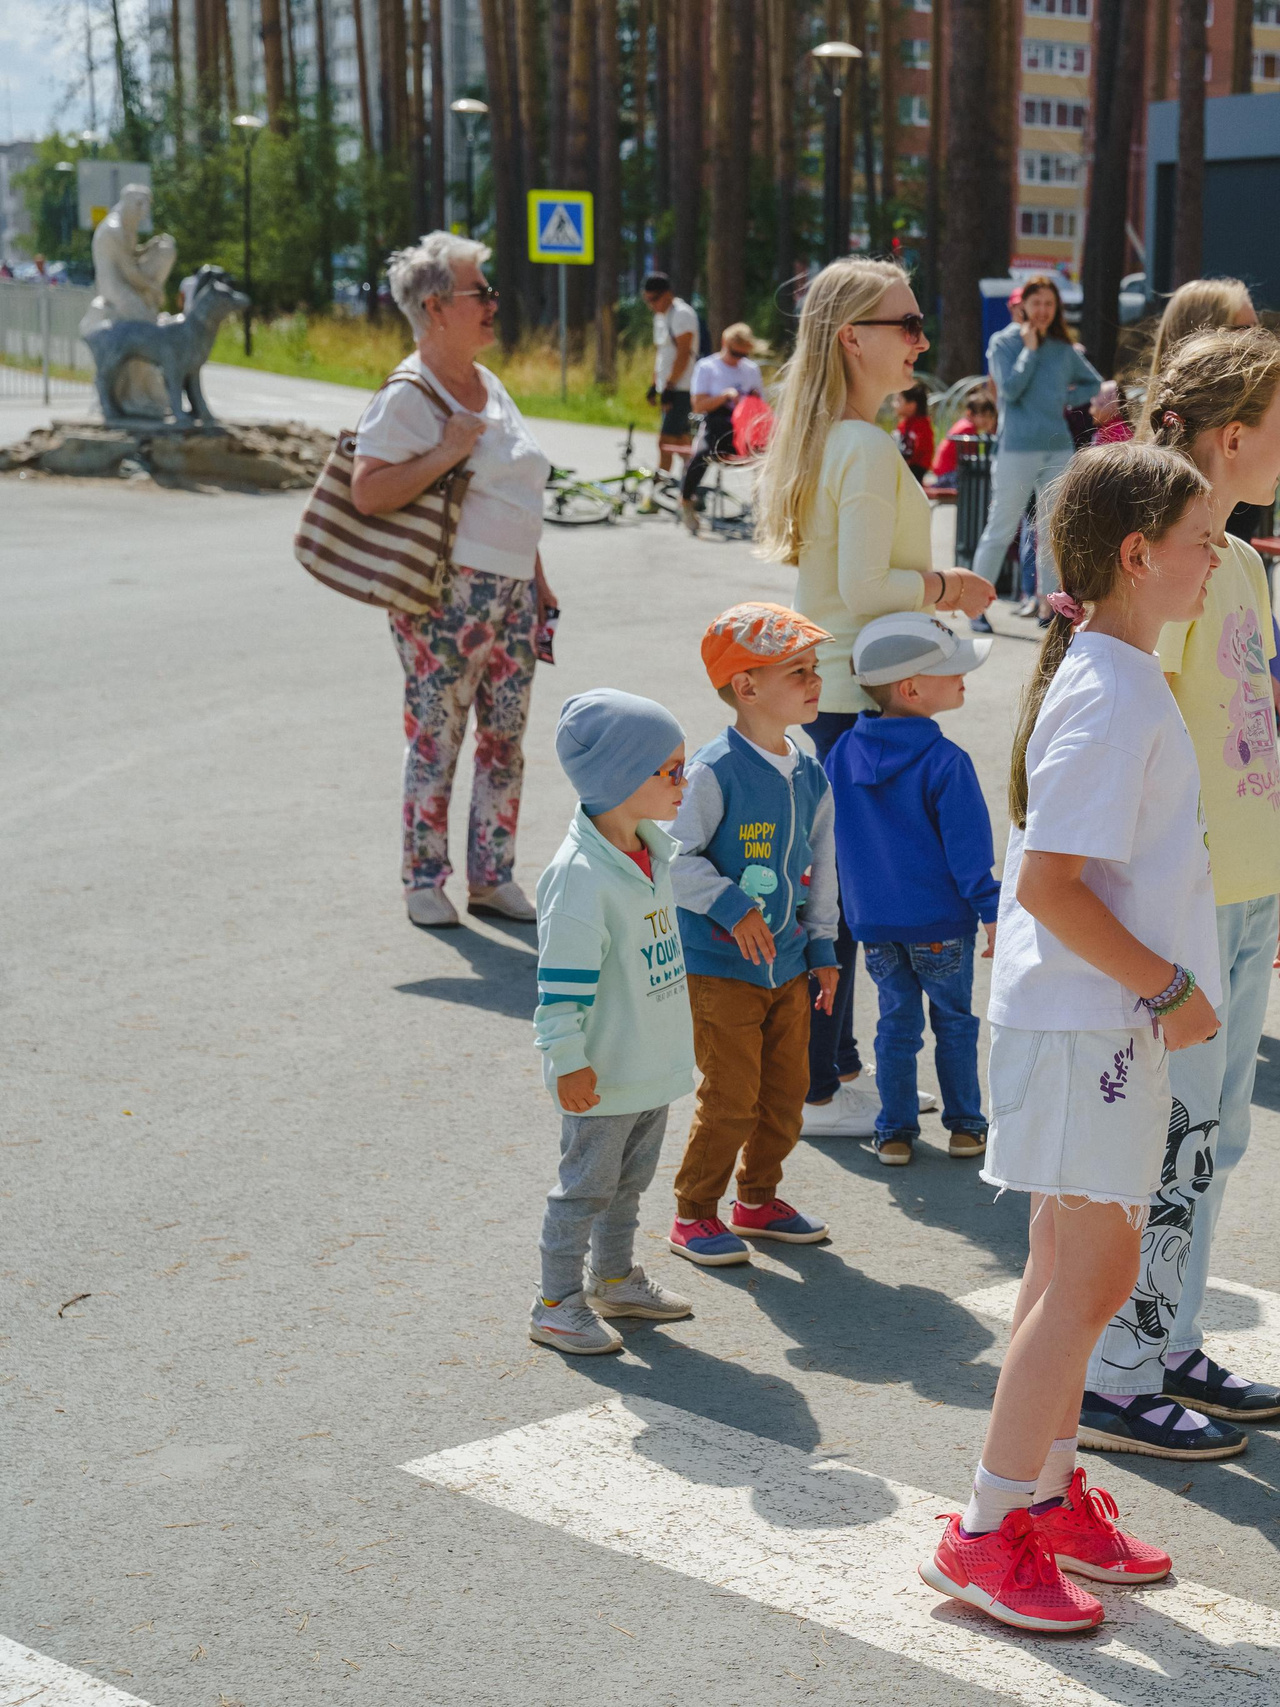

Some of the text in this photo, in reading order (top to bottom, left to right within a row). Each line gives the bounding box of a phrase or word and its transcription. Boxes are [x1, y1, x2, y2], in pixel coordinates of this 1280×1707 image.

[739, 822, 776, 841] HAPPY
[744, 841, 772, 859] DINO
[650, 974, 662, 987] to
